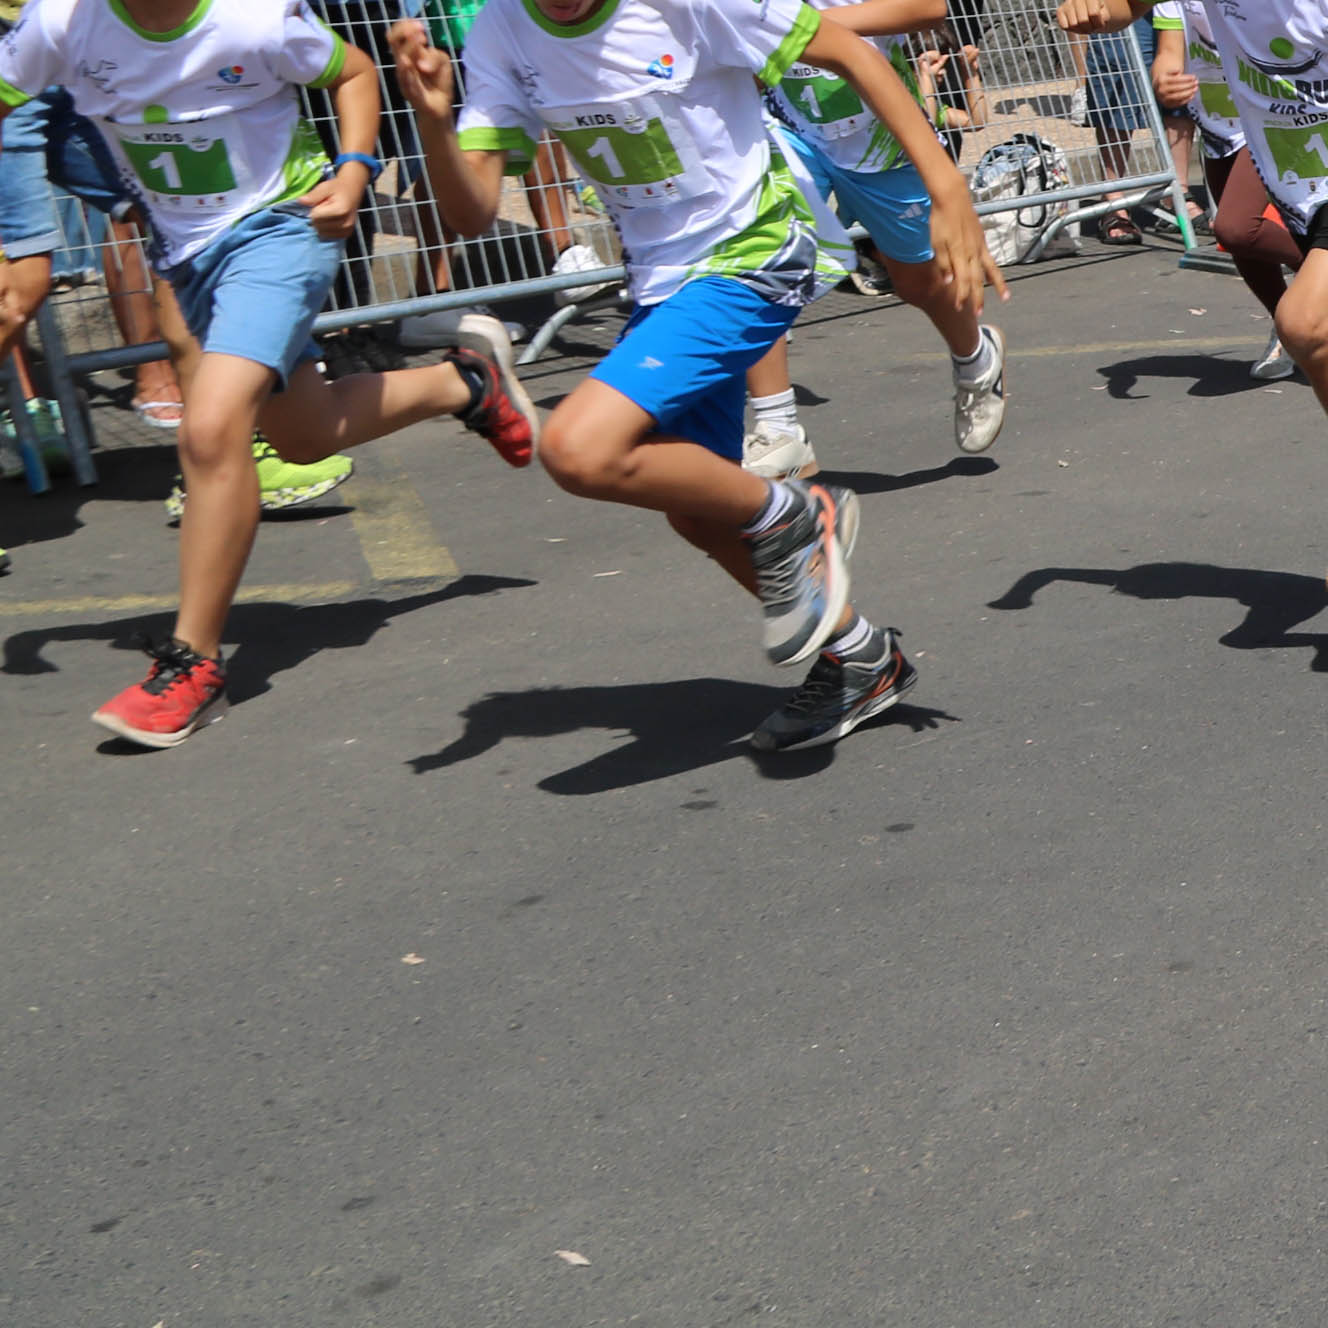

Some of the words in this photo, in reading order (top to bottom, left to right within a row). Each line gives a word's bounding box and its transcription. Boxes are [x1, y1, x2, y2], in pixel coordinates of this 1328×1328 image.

[801, 85, 823, 118] 1
[576, 113, 616, 127] KIDS
[1293, 112, 1328, 127] KIDS
[144, 132, 184, 143] KIDS
[587, 136, 626, 178] 1
[149, 151, 183, 189] 1
